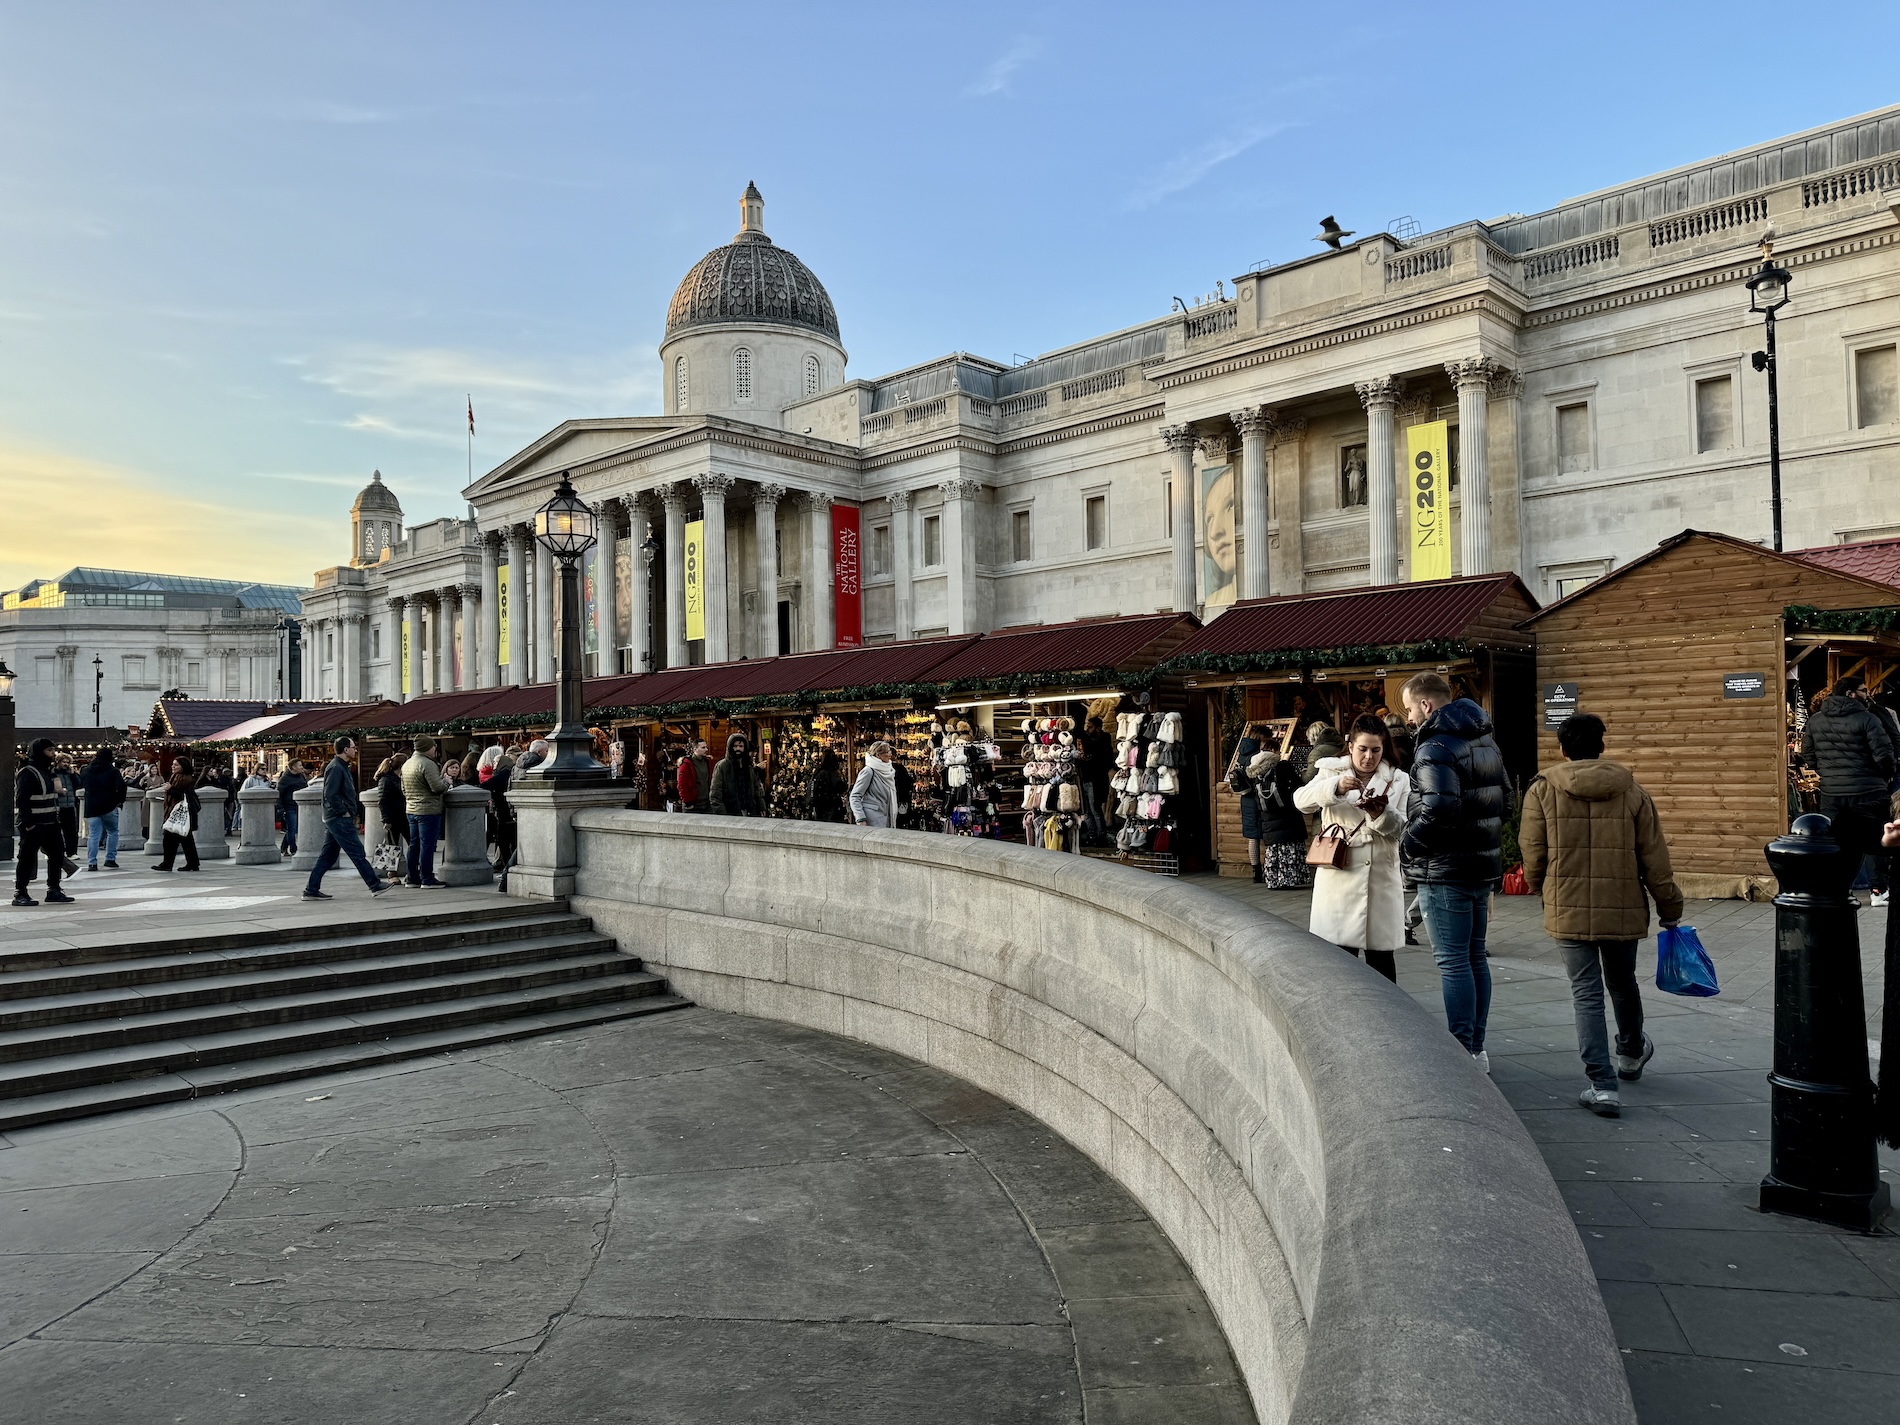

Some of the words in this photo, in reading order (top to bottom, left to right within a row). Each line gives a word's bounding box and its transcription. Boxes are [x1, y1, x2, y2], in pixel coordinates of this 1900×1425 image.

[600, 461, 652, 484] GALLERY
[1415, 450, 1436, 549] NG200
[687, 542, 697, 614] NG200
[839, 527, 849, 594] NATIONAL
[847, 528, 857, 595] GALLERY
[500, 582, 508, 643] NG200
